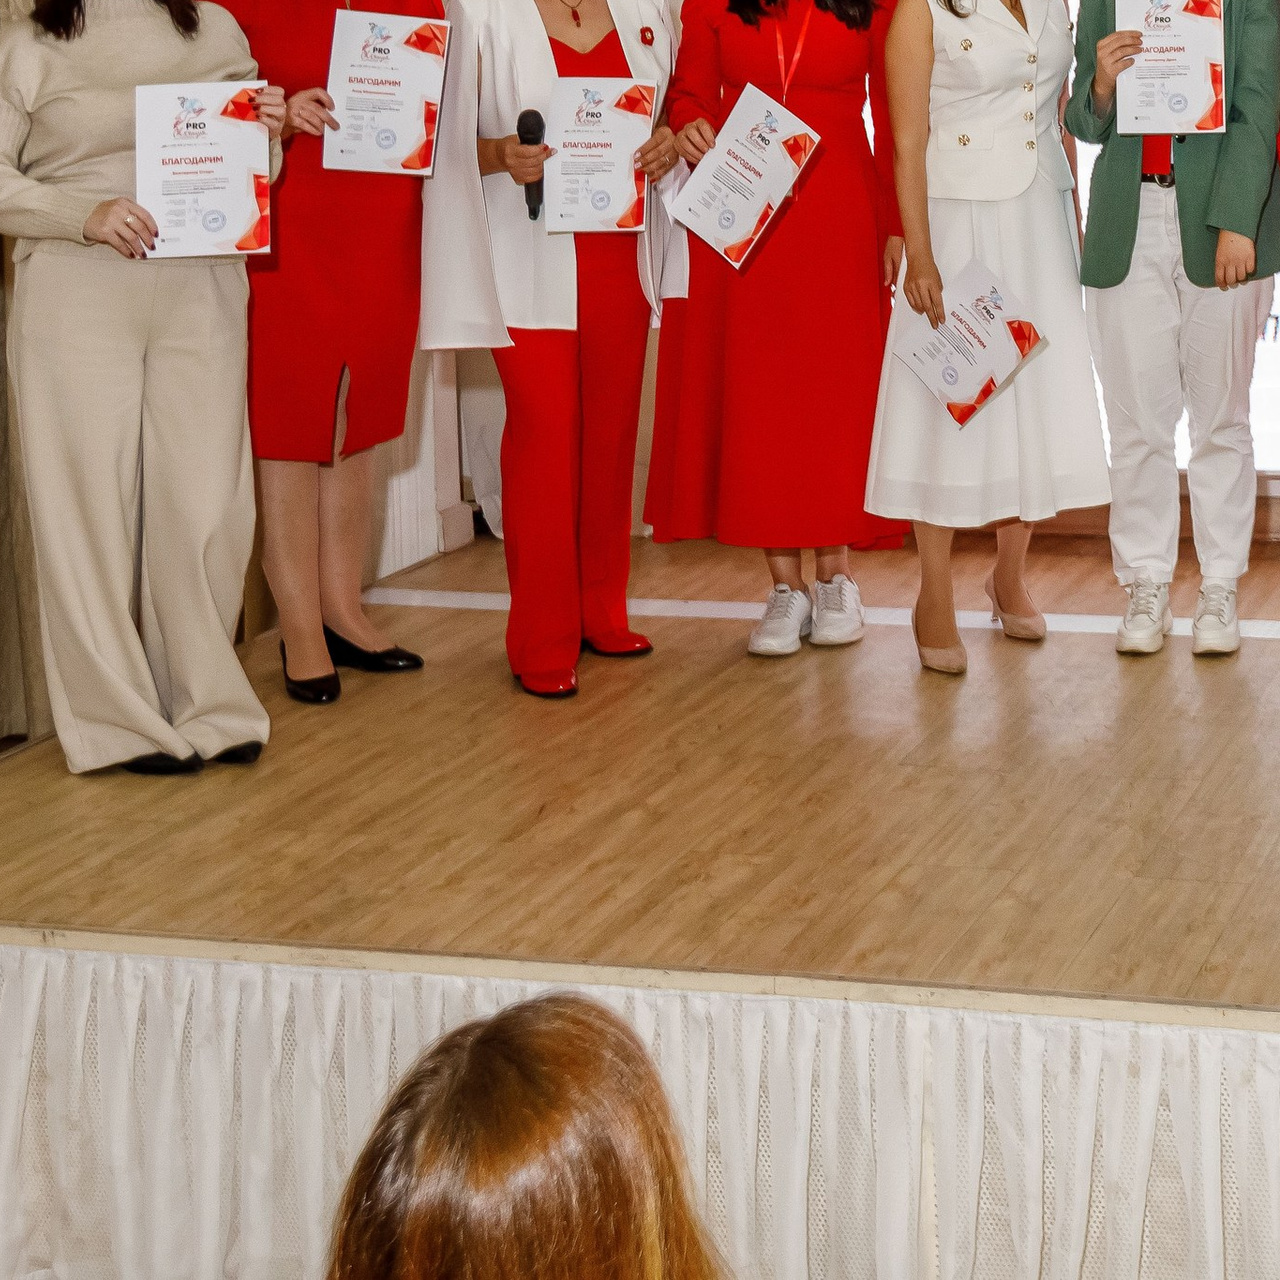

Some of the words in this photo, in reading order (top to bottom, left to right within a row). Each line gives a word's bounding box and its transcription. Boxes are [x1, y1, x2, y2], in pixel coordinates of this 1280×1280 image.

[372, 46, 391, 55] PRO
[1141, 46, 1186, 54] ЛАГОДАРИМ
[348, 76, 401, 88] БЛАГОДАРИМ
[585, 111, 602, 119] PRO
[186, 122, 206, 130] PRO
[756, 133, 771, 146] PRO
[562, 141, 613, 150] БЛАГОДАРИМ
[161, 155, 224, 166] БЛАГОДАРИМ
[726, 148, 763, 179] БЛАГОДАРИМ
[982, 305, 995, 320] PRO
[950, 310, 987, 350] БЛАГОДАРИМ
